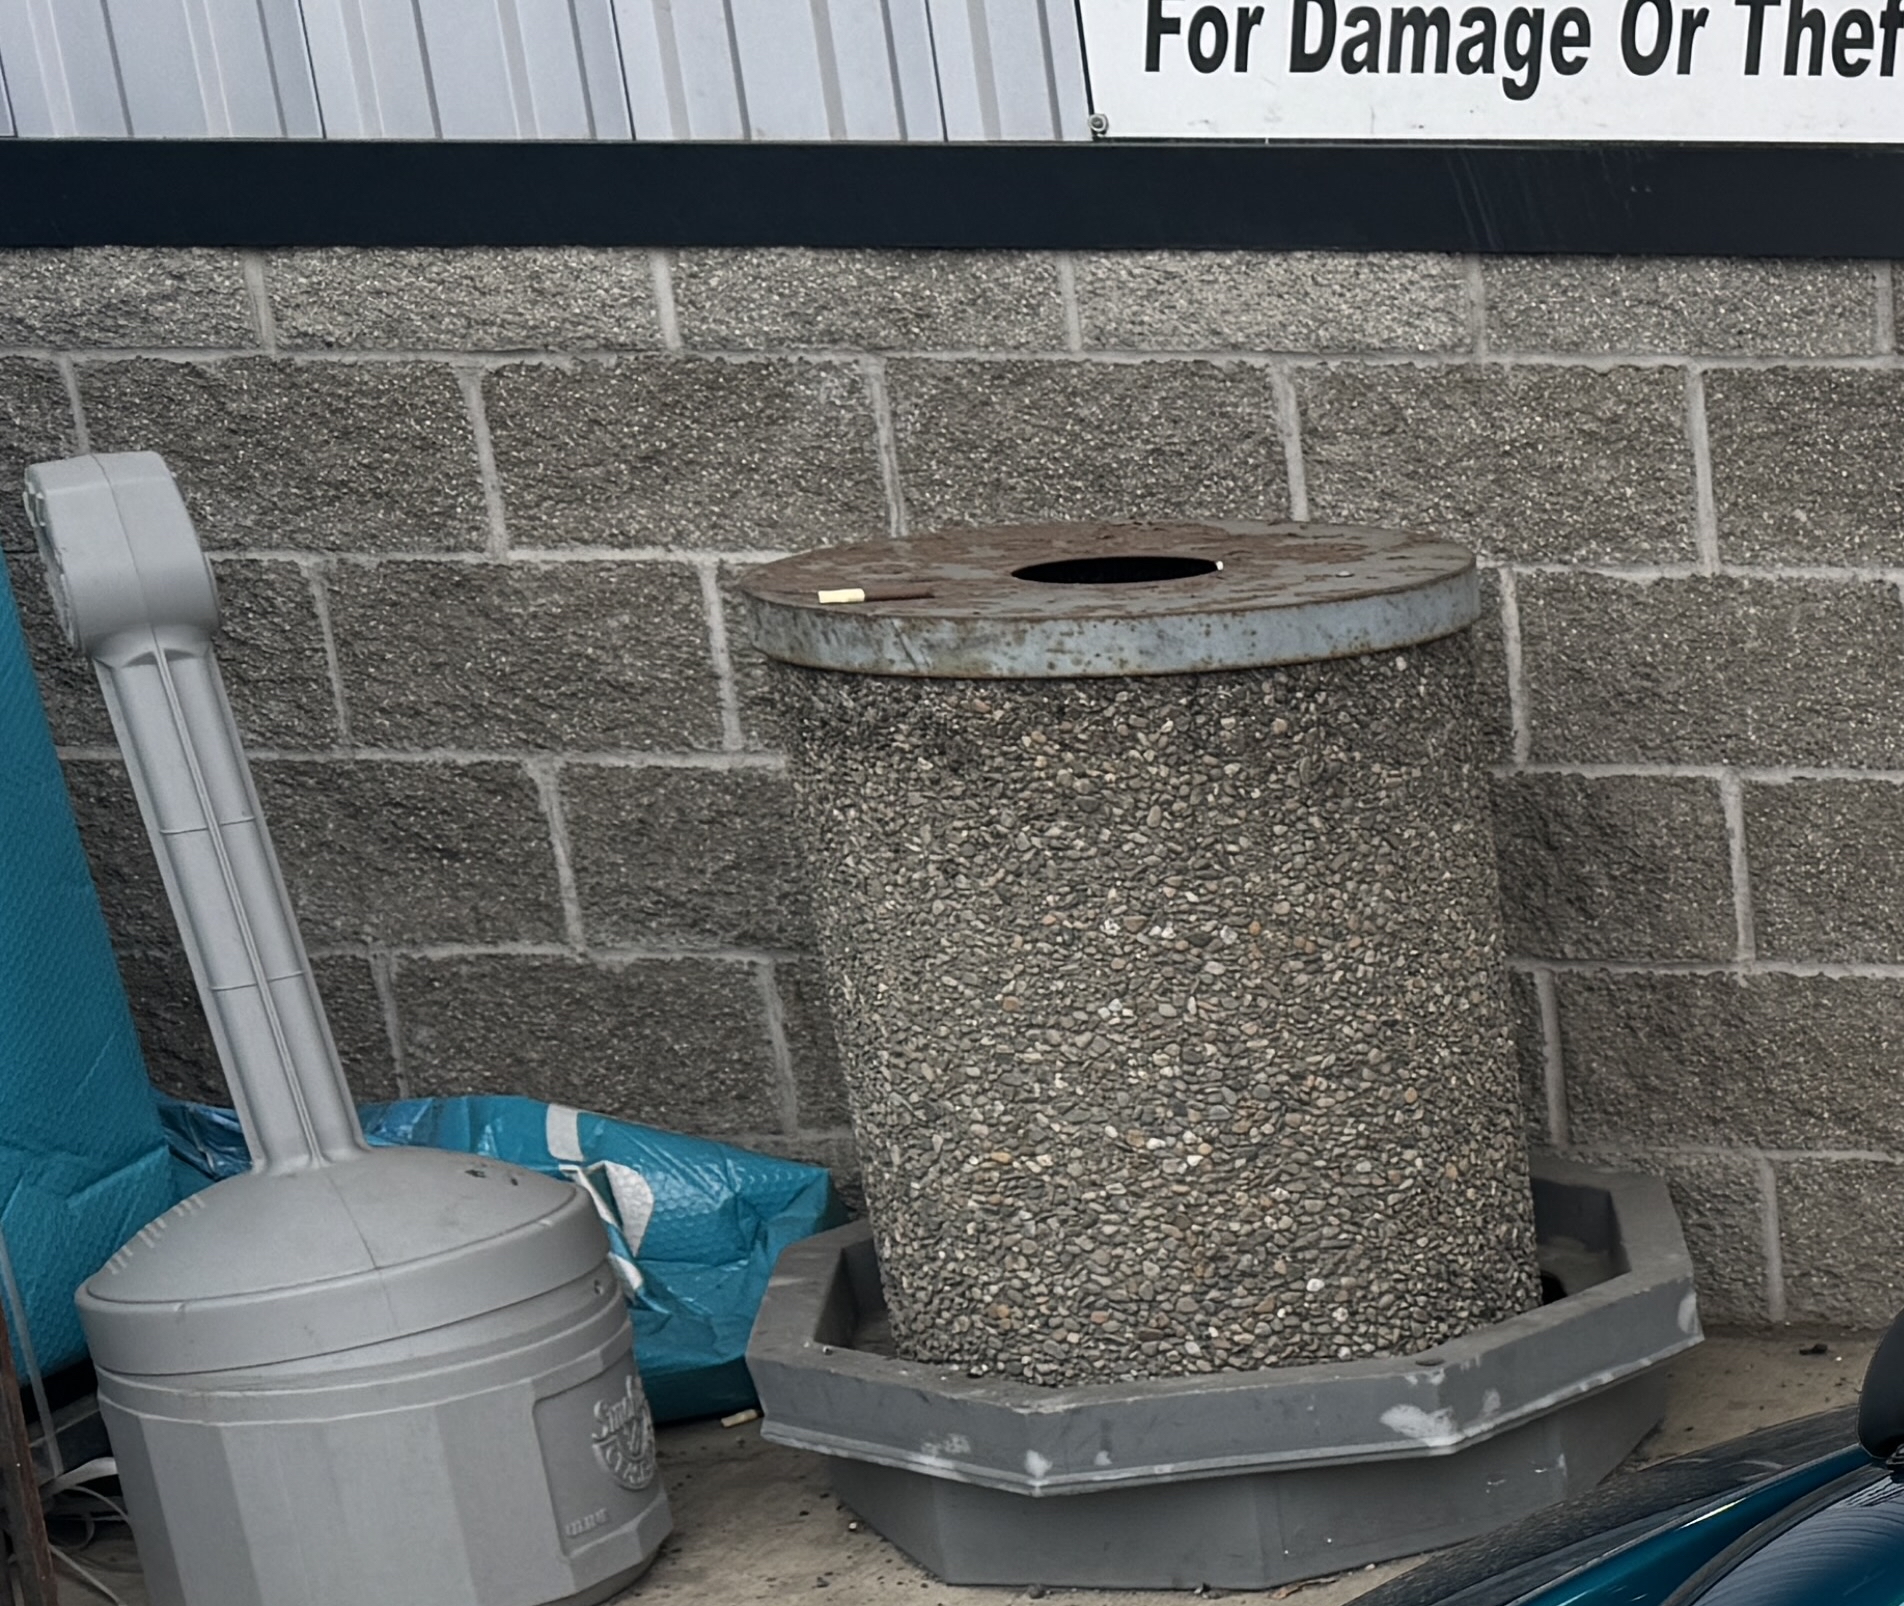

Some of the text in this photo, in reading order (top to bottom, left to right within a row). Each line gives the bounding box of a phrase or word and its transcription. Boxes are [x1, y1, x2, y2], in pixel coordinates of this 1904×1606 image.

[1146, 0, 1264, 74] For
[1290, 0, 1590, 101] Damage
[1622, 0, 1709, 76] Or
